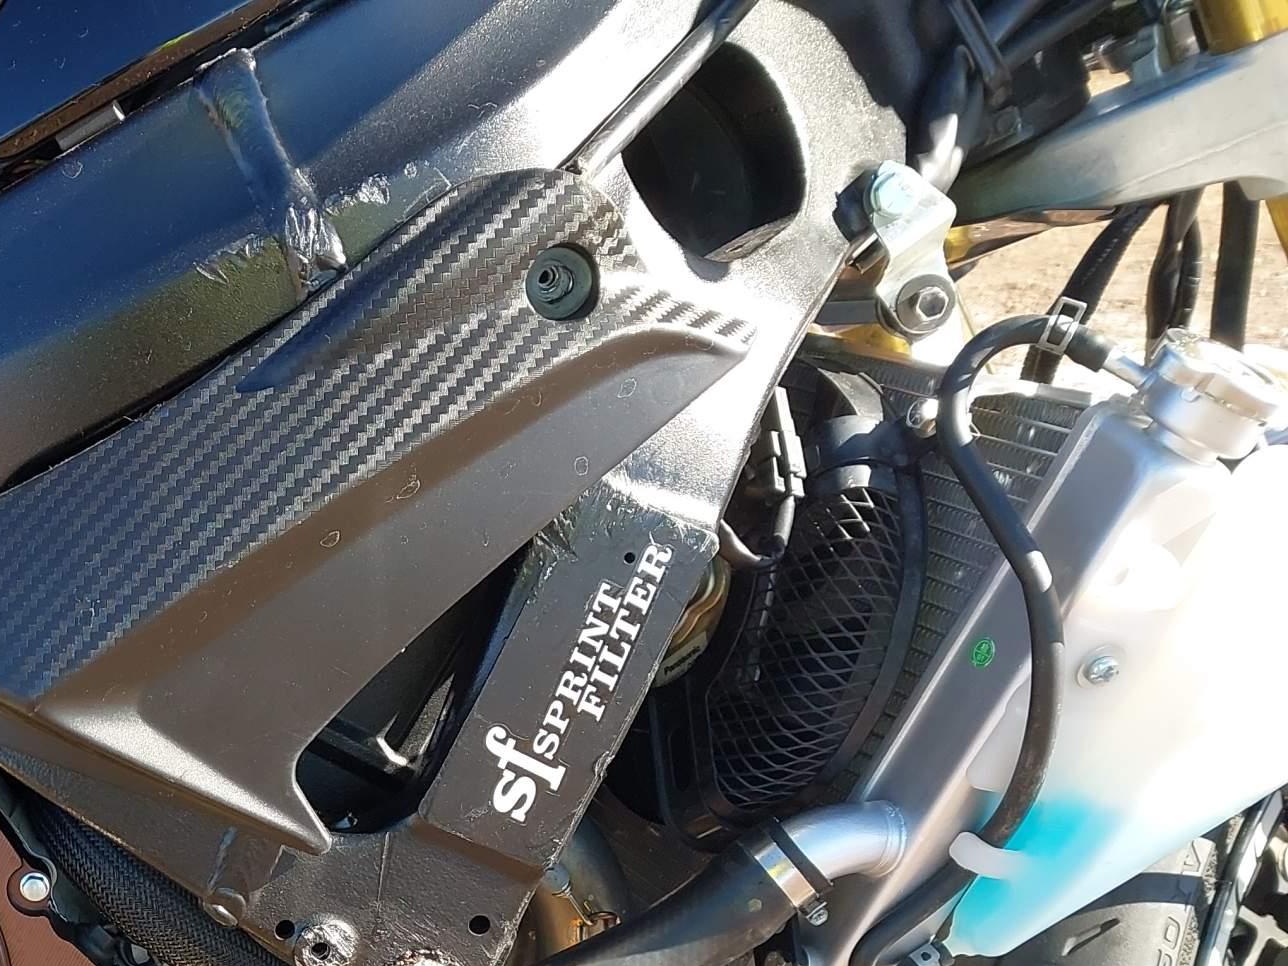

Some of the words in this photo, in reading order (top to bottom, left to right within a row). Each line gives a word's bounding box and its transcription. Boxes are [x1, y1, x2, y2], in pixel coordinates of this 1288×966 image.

[533, 582, 623, 760] SPRINT
[576, 543, 673, 722] FILTER
[485, 725, 567, 823] sf
